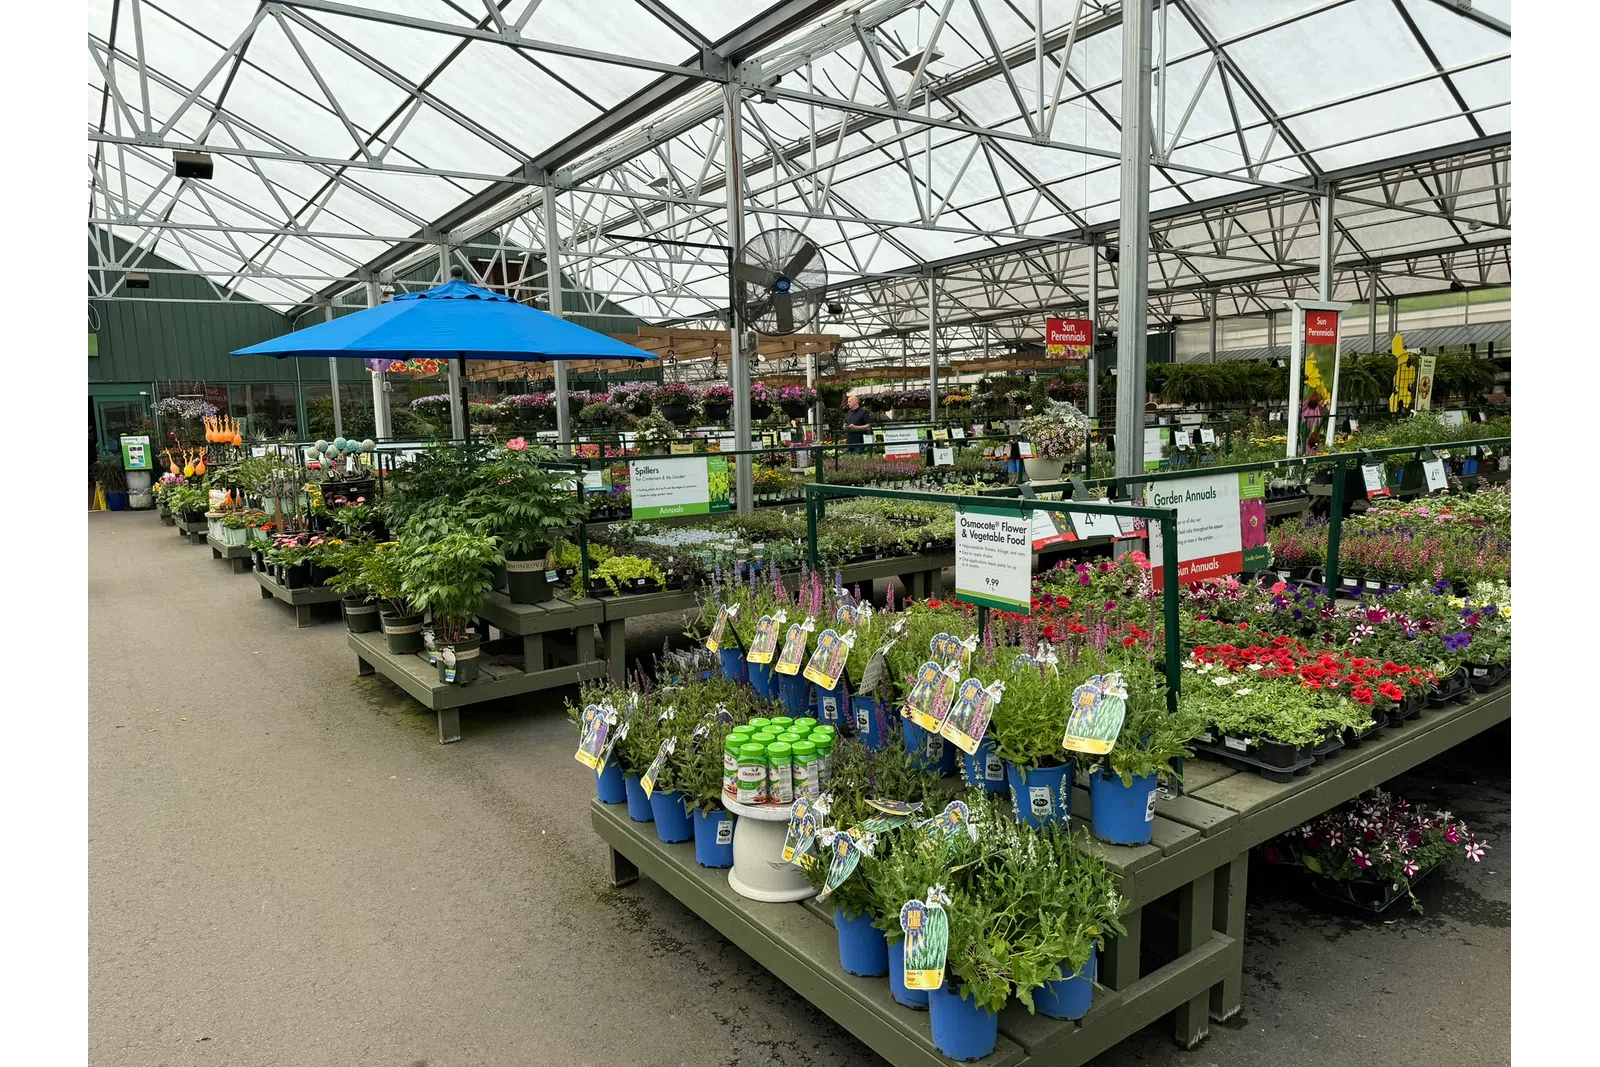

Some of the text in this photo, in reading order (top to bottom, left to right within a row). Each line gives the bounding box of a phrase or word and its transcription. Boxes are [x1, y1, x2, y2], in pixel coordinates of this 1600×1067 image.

[1317, 316, 1326, 325] Sun
[1062, 321, 1075, 331] Sun
[1051, 330, 1086, 341] Perennials
[1308, 328, 1334, 336] Perennials
[635, 466, 659, 476] Spillers
[1154, 486, 1216, 506] Garden Annuals
[659, 505, 684, 514] Annuals
[1002, 522, 1027, 534] Flower
[962, 529, 1025, 546] & Vegetable Food
[1191, 557, 1219, 574] Annuals
[985, 577, 1000, 586] 9.99
